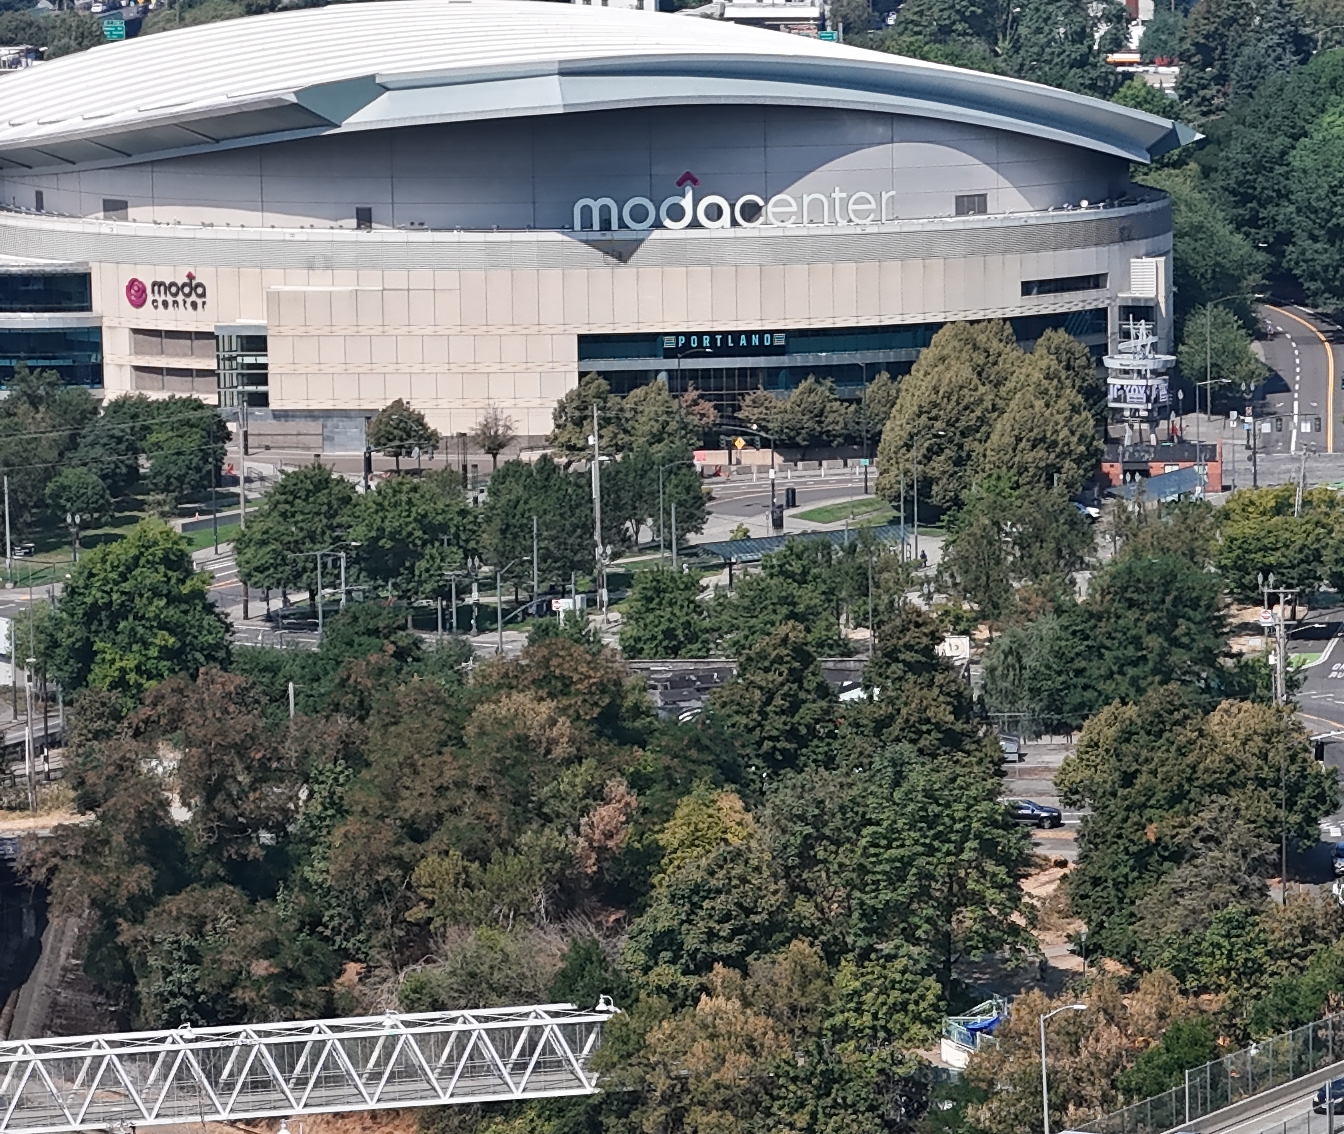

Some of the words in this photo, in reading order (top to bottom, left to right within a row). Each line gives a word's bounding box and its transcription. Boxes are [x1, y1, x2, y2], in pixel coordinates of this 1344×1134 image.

[151, 276, 207, 299] moda
[151, 298, 207, 312] center
[678, 333, 771, 348] PORTLAND
